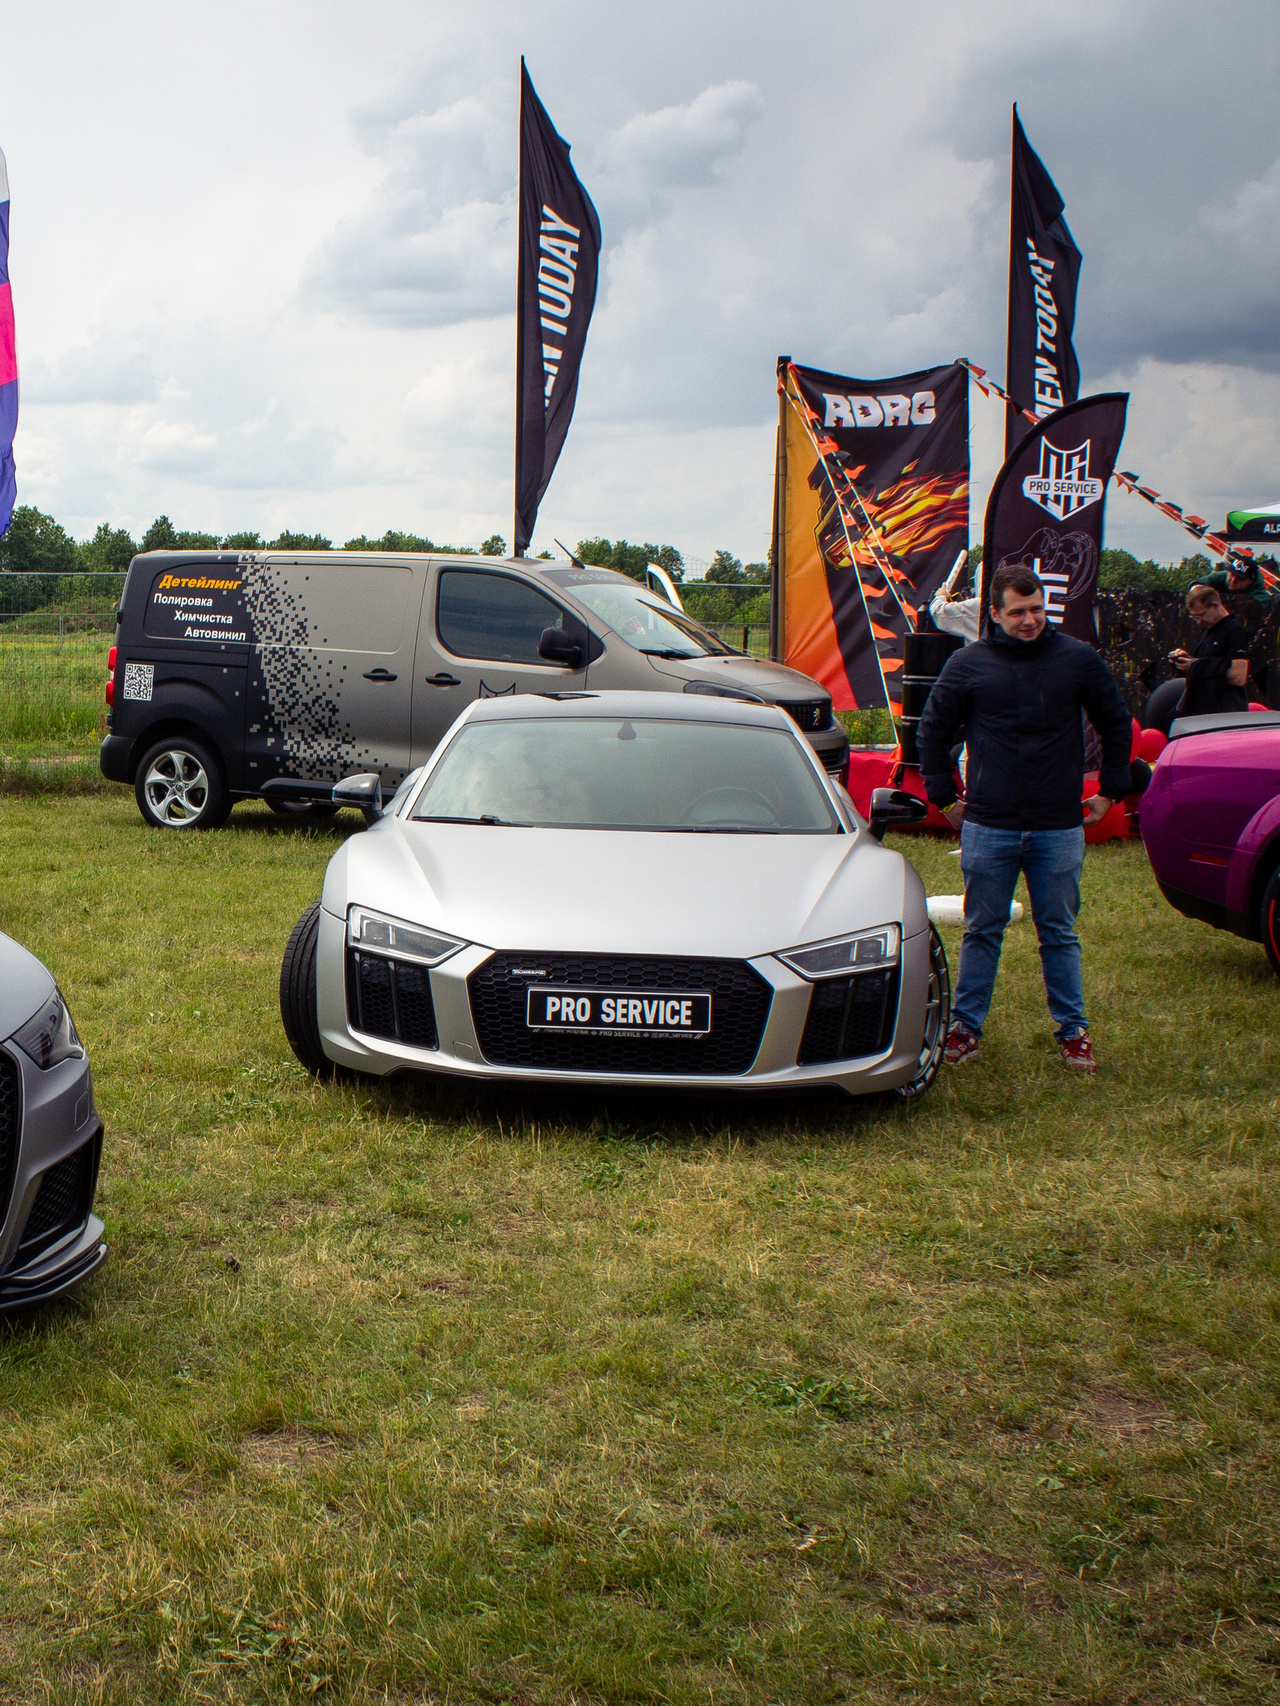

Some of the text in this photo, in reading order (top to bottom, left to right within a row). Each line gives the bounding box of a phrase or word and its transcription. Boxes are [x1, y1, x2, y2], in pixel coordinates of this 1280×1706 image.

[1029, 481, 1097, 494] PRO SERVICE
[158, 574, 242, 590] Детейлинг
[153, 593, 213, 607] Полировка
[173, 610, 233, 624] Химчистка
[184, 626, 246, 641] Автовинил
[546, 996, 692, 1025] PRO SERVICE
